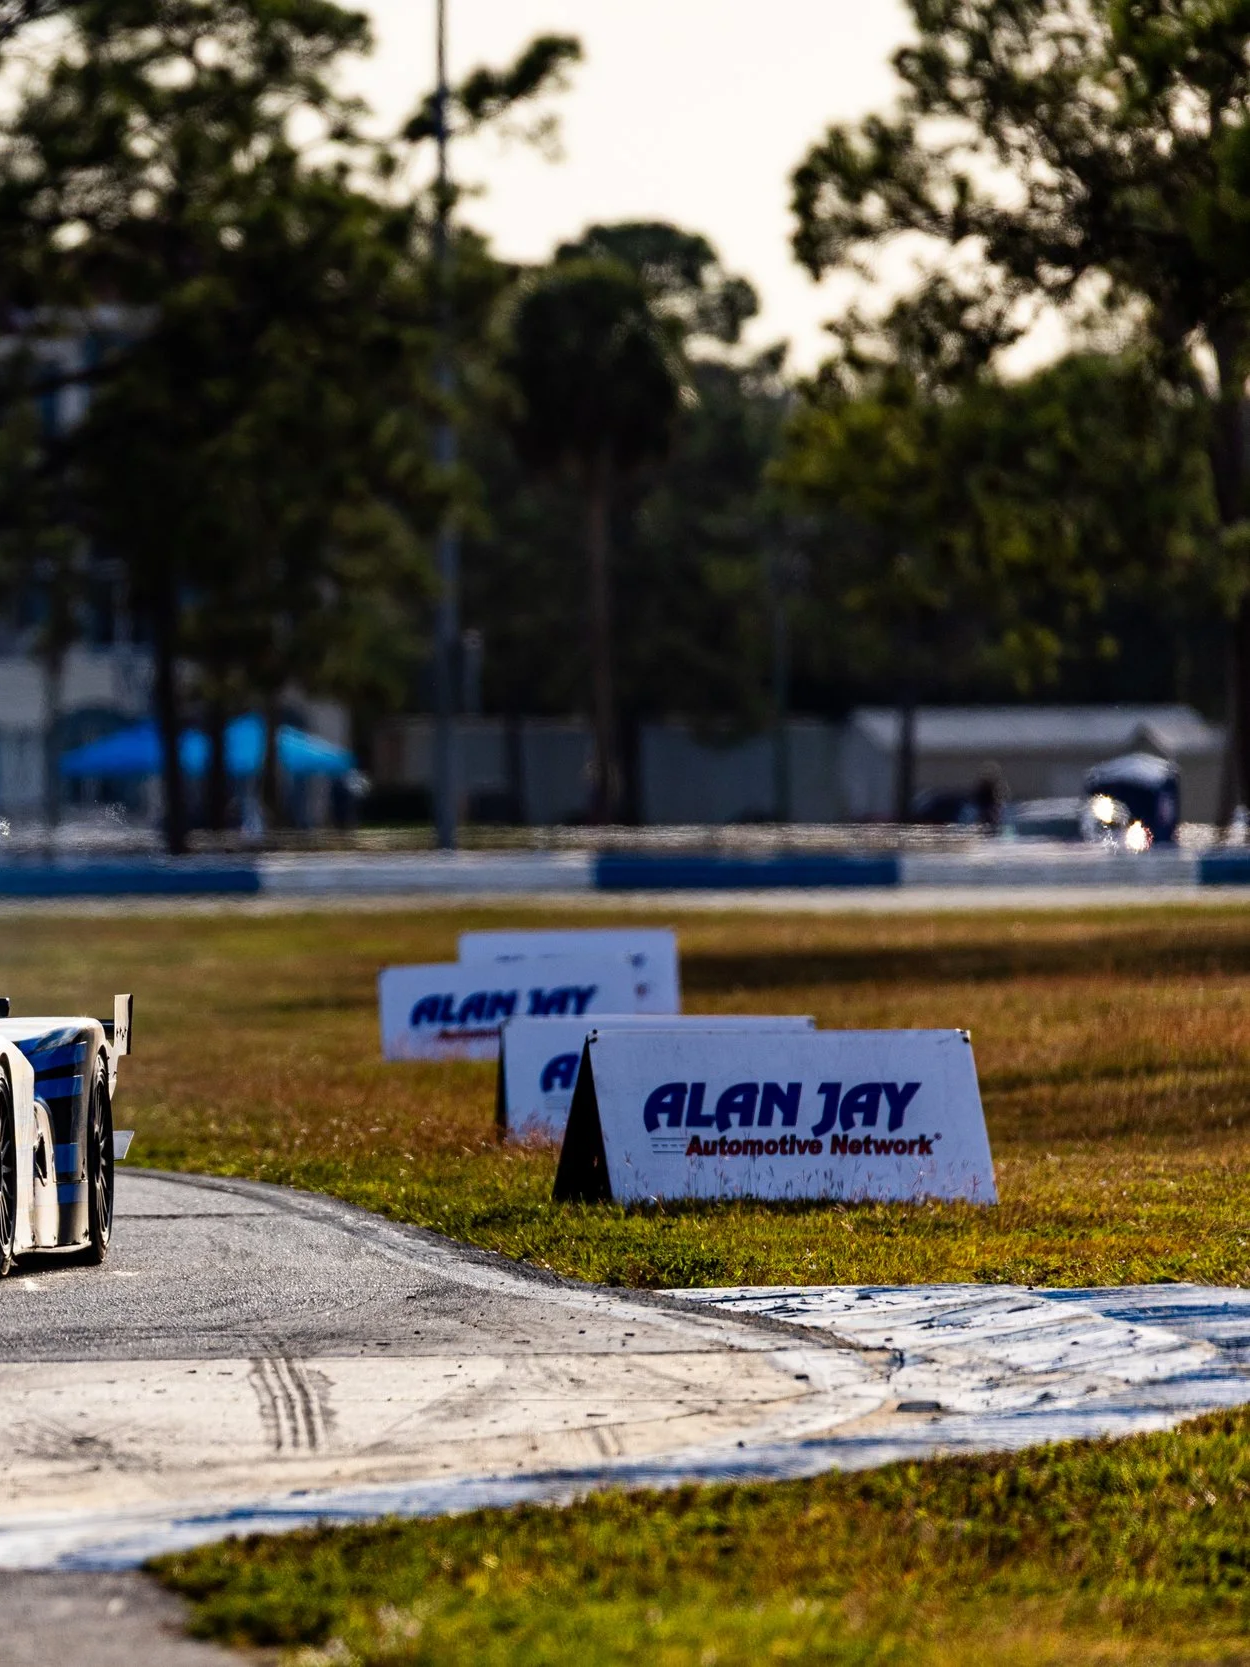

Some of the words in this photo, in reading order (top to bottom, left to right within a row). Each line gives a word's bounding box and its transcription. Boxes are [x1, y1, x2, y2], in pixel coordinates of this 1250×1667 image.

[409, 988, 519, 1028] ALAN
[643, 1081, 803, 1133] ALAN
[810, 1081, 922, 1138] JAY
[685, 1134, 824, 1157] Automotive
